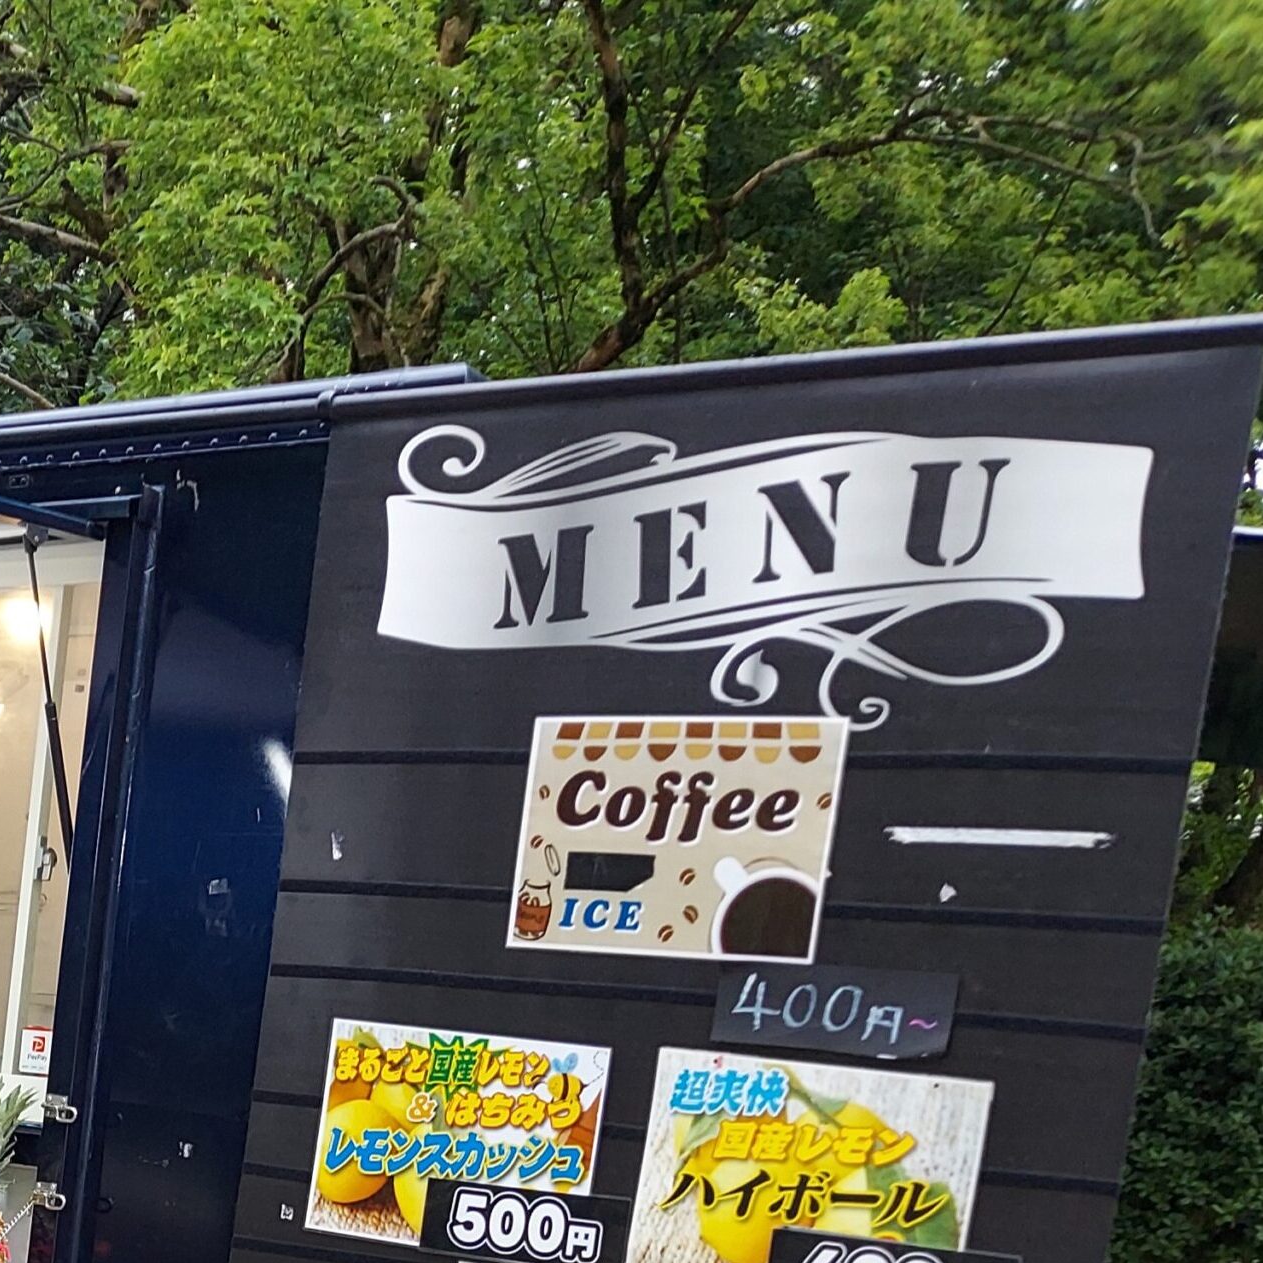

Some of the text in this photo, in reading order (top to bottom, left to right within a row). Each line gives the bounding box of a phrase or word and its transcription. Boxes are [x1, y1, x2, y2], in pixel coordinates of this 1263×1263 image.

[493, 458, 1011, 630] MENU
[556, 770, 801, 842] Coffee
[558, 898, 643, 931] ICE
[407, 1091, 584, 1130] & はちみつ
[670, 1069, 790, 1114] 超爽快
[325, 1128, 586, 1183] レモンスカッシュ
[713, 1122, 915, 1166] 国産レモン
[451, 1192, 599, 1261] 500円
[660, 1170, 949, 1228] ハイボール
